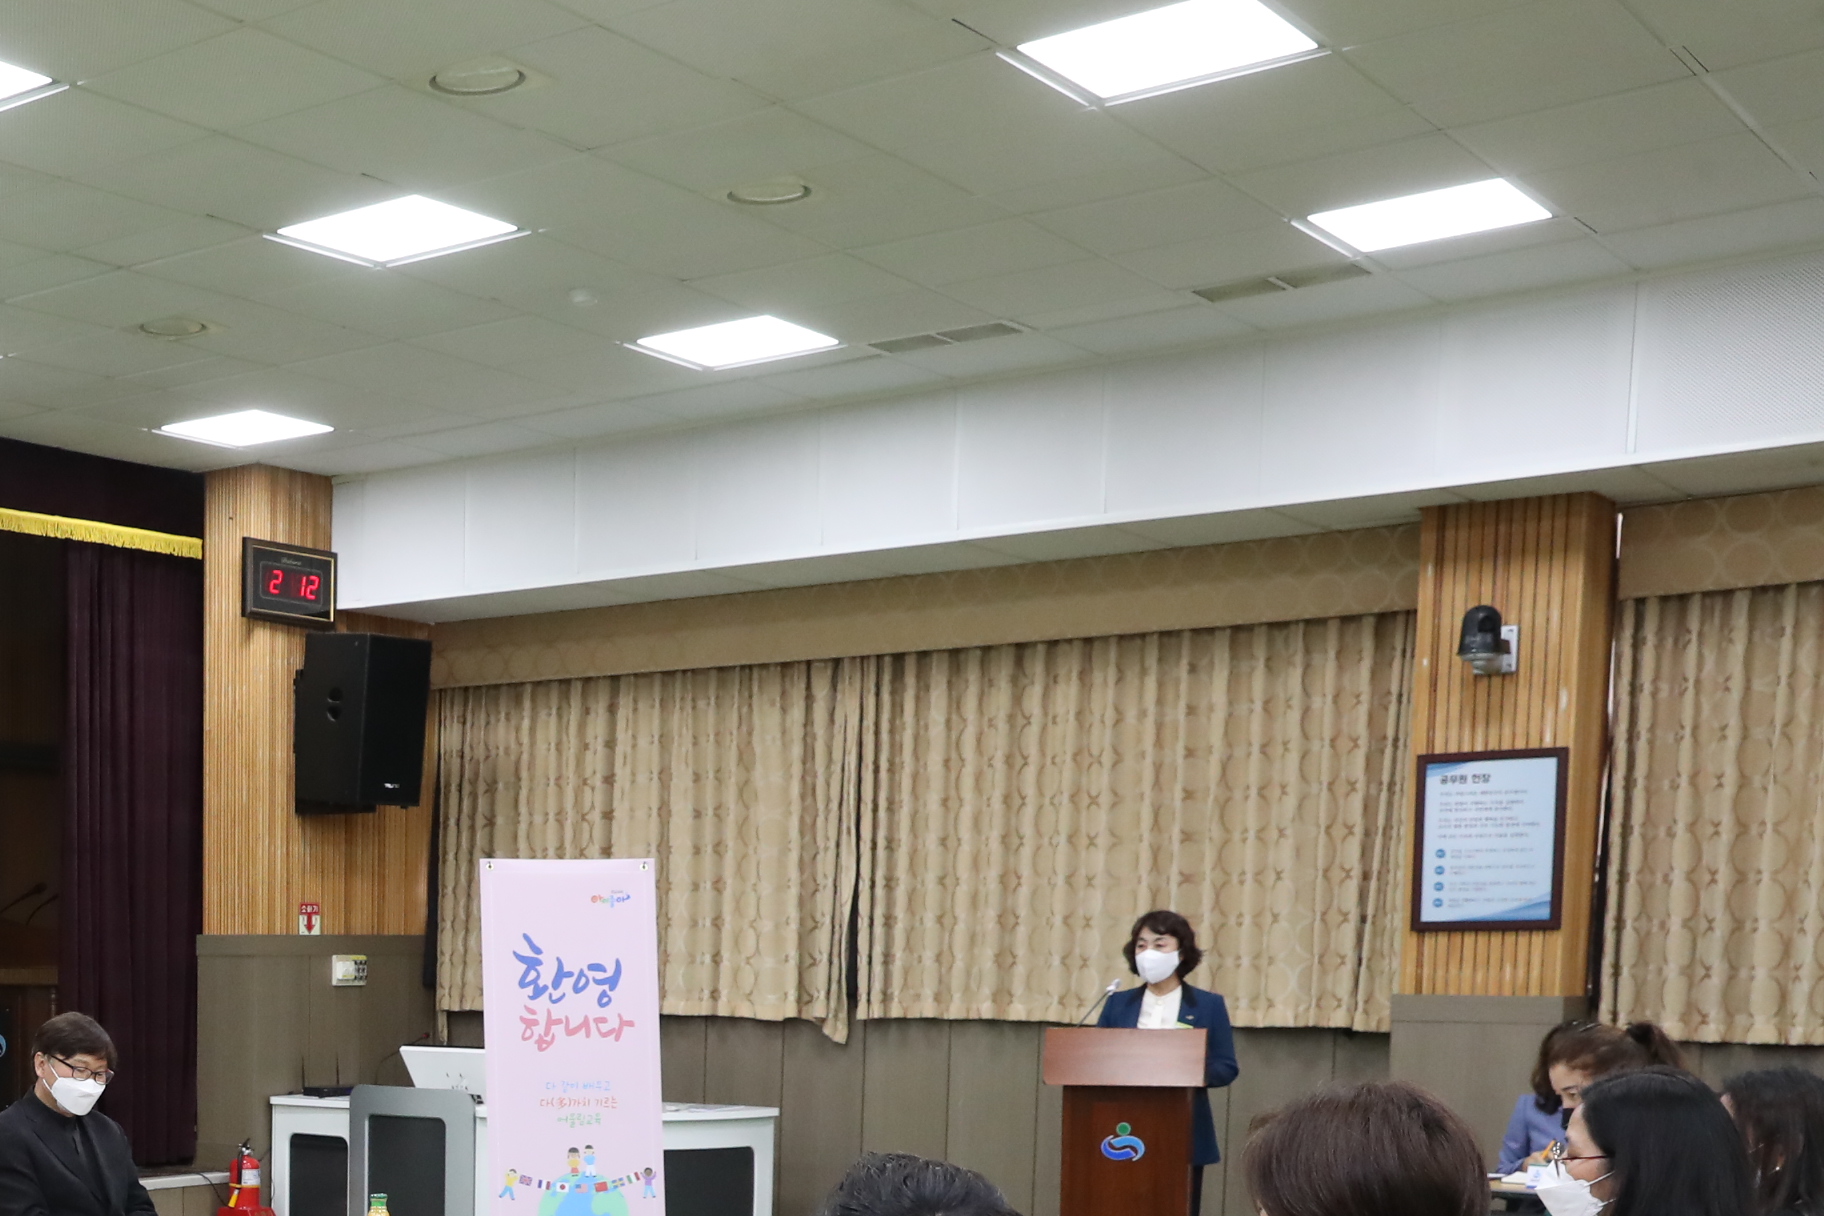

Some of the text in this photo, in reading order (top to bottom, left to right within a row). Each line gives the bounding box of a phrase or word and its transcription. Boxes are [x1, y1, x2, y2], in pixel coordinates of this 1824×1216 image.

[300, 575, 321, 600] 12
[512, 932, 622, 1009] 환영
[519, 1004, 636, 1052] 합니다
[583, 1080, 611, 1092] 배우고
[595, 1096, 618, 1109] 기르는
